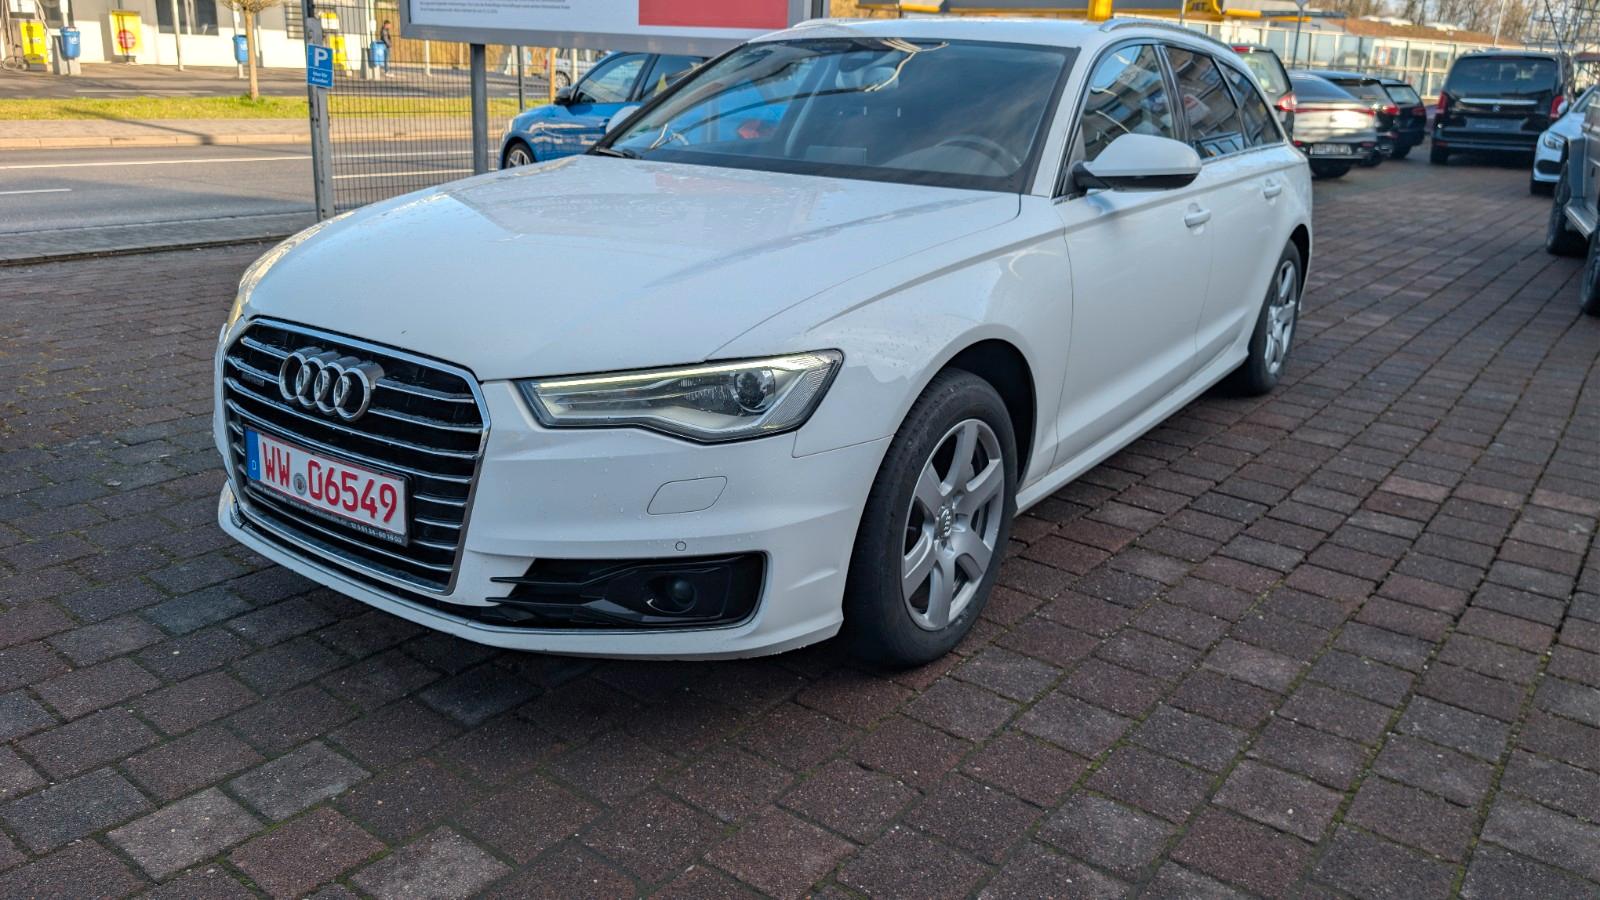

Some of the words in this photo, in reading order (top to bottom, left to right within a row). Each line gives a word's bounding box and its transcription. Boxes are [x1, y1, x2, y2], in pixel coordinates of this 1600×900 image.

[314, 48, 328, 66] P
[262, 442, 290, 488] WW
[308, 460, 397, 523] 06549
